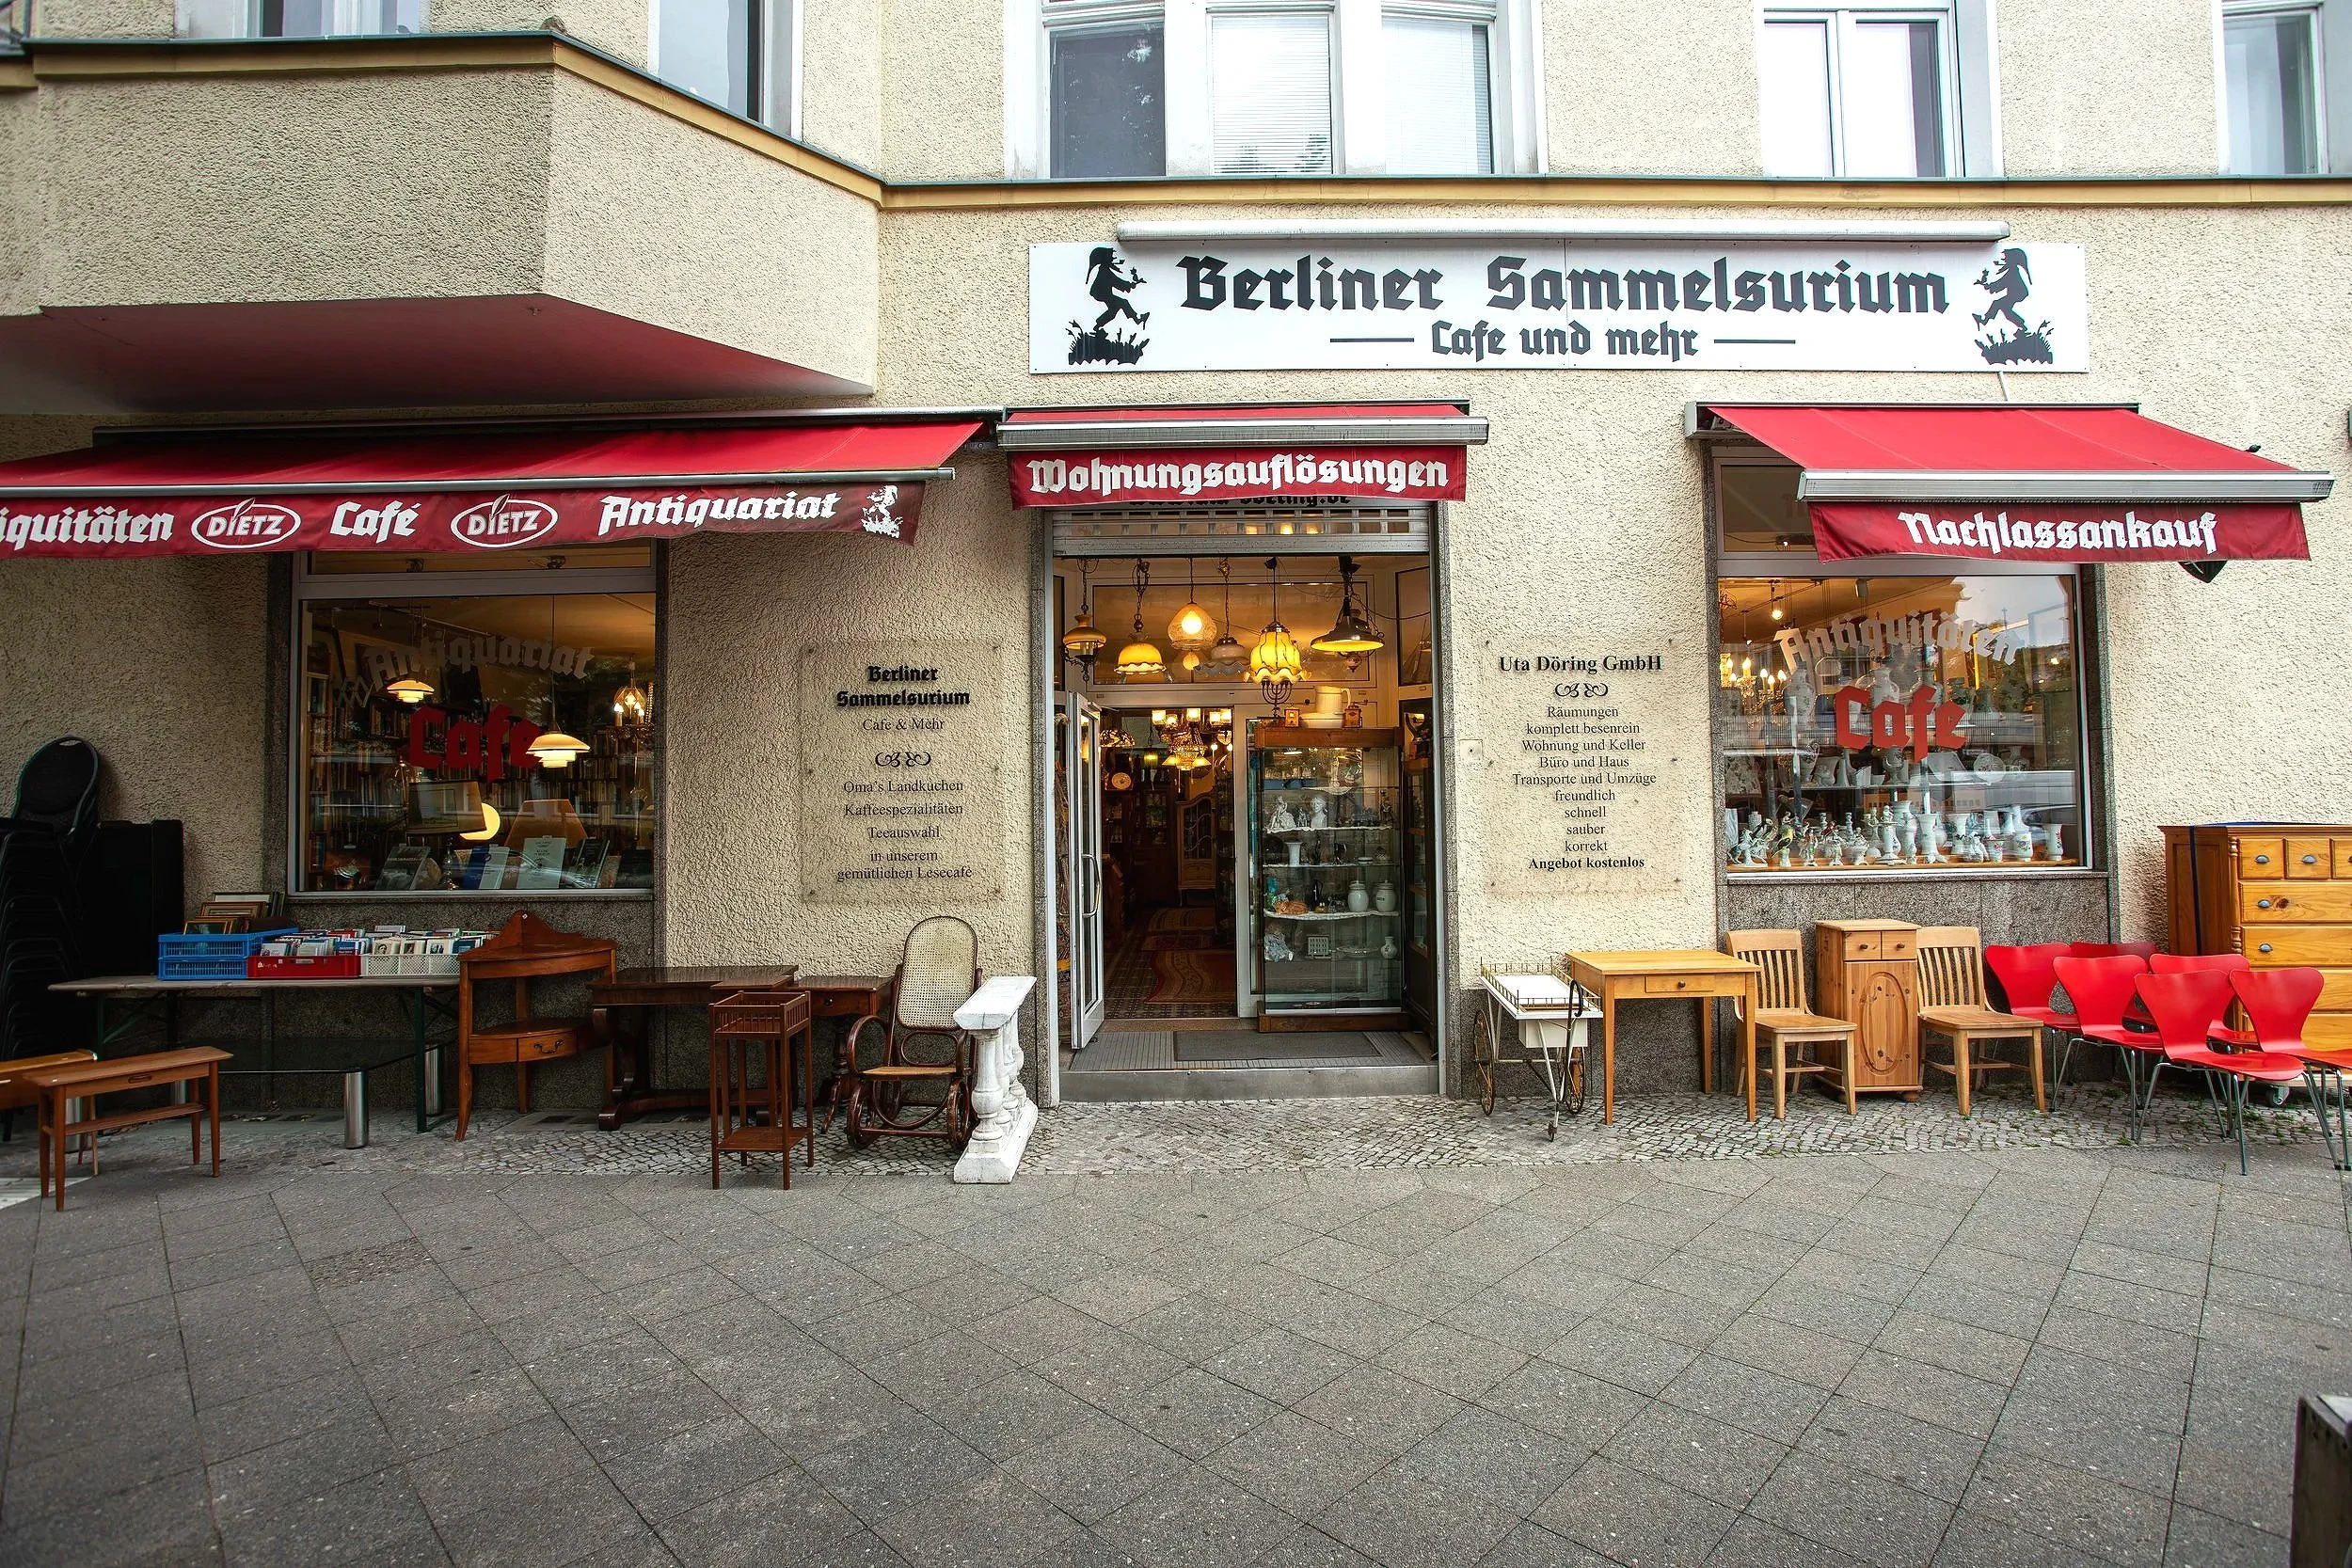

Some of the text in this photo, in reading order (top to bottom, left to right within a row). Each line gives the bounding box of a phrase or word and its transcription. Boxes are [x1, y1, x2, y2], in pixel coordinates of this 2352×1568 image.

[1176, 254, 1949, 313] Berliner Sammelsurium
[1432, 320, 1698, 362] Cafe und mehr
[1026, 453, 1449, 496] Wohnungsauflösungen
[206, 515, 286, 537] DIETZ
[330, 500, 421, 544] Café
[467, 510, 541, 535] DIETZ
[597, 491, 841, 535] Antiquariat
[1898, 511, 2217, 554] Nachlassankauf
[1773, 610, 2020, 675] Antiquitäten
[362, 631, 595, 688] Antiquariat
[1500, 655, 1661, 674] Uta Döring GmbH
[867, 665, 939, 682] Berliner
[836, 689, 971, 707] Sammelsurium
[1547, 706, 1619, 720] Räumungen
[863, 718, 946, 730] Cafe & Mehr
[1527, 722, 1640, 736] komplett besenrein
[1836, 684, 1966, 763] Cafe
[409, 704, 543, 784] Cafe
[1521, 738, 1645, 753] Wohnung und Keller
[1540, 756, 1629, 768] Büro und Haus
[843, 780, 963, 793] Oma's Landkuchen
[1513, 772, 1657, 787] Transporte und Umzüge
[1555, 790, 1615, 801] freundlich
[845, 803, 963, 817] Kaffeespezialitäten
[1565, 806, 1606, 817] schnell
[867, 826, 940, 838] Teeauswahl
[1566, 824, 1605, 834] sauber
[1565, 841, 1608, 851] korrekt
[870, 850, 938, 862] in unserem
[1529, 857, 1645, 871] Angebot kostenlos
[836, 867, 913, 882] gemütlichen
